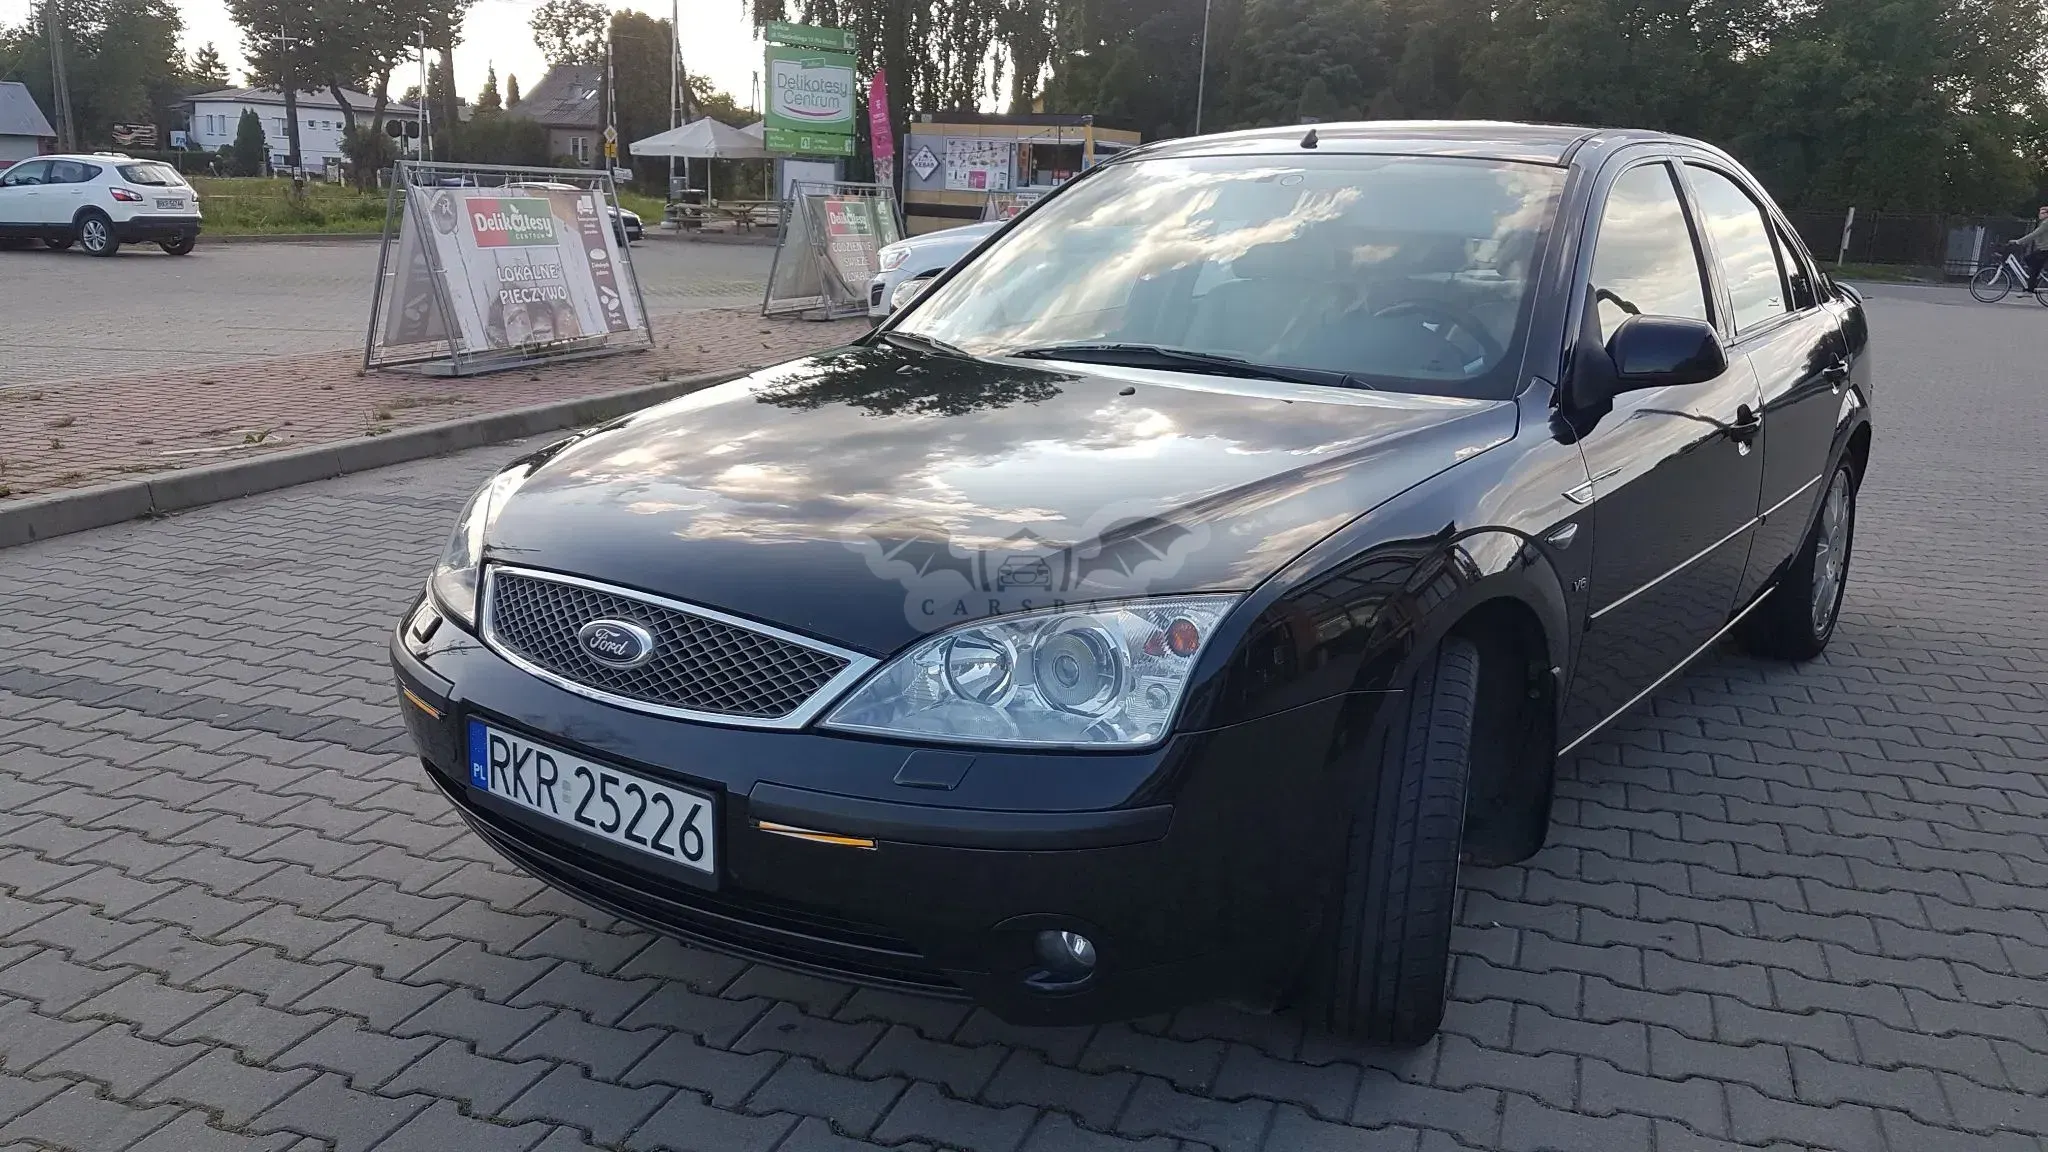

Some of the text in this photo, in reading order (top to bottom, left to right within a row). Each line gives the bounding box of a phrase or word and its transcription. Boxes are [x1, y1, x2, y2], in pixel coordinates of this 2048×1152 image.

[777, 72, 848, 97] Delikatesy
[783, 89, 840, 108] Centrum
[474, 211, 552, 238] Delikatesy
[497, 264, 558, 281] LOKALNE
[499, 286, 567, 305] PIECZYWO
[1573, 577, 1587, 592] V6
[589, 628, 629, 655] Ford
[473, 762, 486, 781] PL
[489, 733, 703, 862] RKR 25226
